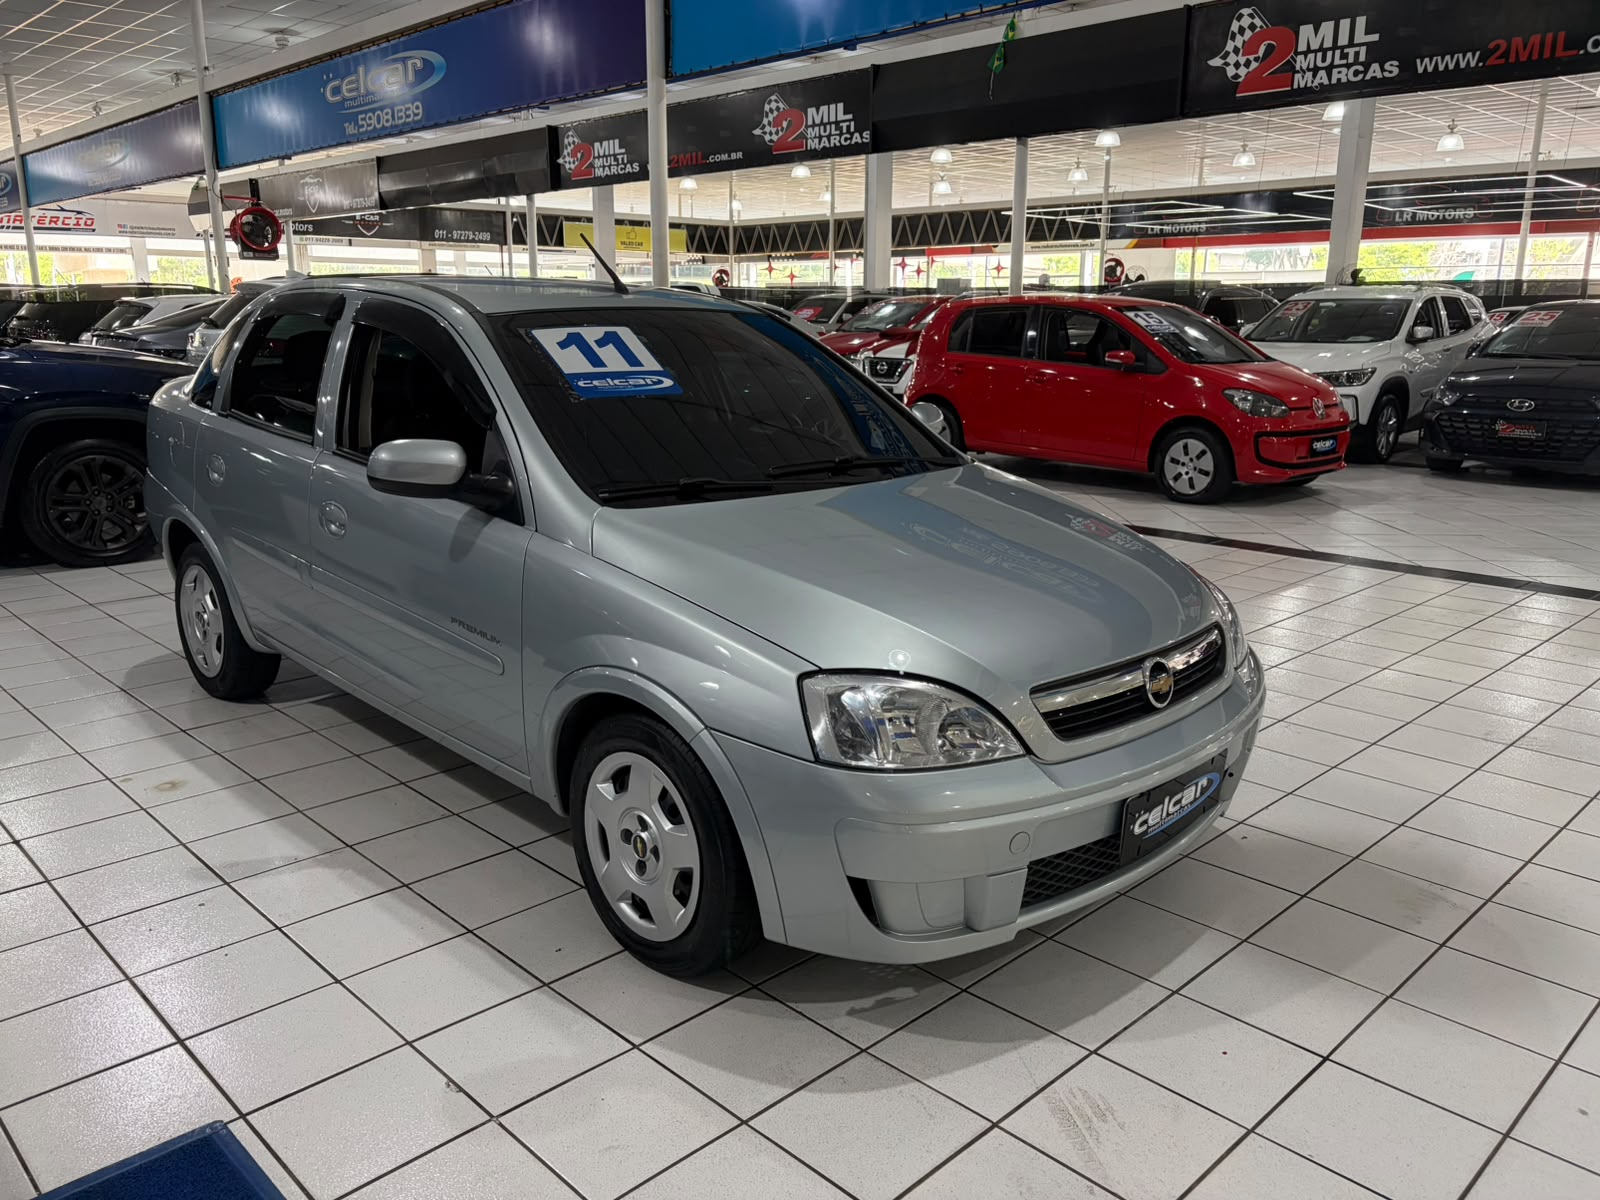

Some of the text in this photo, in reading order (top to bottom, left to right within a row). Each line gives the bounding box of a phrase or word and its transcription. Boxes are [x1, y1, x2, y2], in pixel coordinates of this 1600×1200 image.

[1236, 15, 1380, 97] 2 MIL
[1296, 46, 1367, 71] MULTI
[325, 57, 424, 104] celcar
[1293, 60, 1400, 90] MARCAS
[772, 102, 853, 154] 2 MIL
[807, 121, 855, 138] MULTI
[807, 130, 871, 151] MARCAS
[571, 138, 626, 180] 2 MIL
[594, 154, 628, 167] MULTI
[594, 162, 640, 177] MARCAS
[1395, 207, 1475, 222] LR MOTORS
[434, 229, 446, 239] 011
[452, 230, 491, 241] 97279-2499
[1163, 222, 1208, 234] MOTORS
[1134, 312, 1165, 325] 15
[1520, 311, 1559, 322] 25
[556, 330, 645, 369] 11
[577, 378, 658, 388] celcar
[451, 616, 503, 647] PREMIUM
[1134, 776, 1208, 836] celcar
